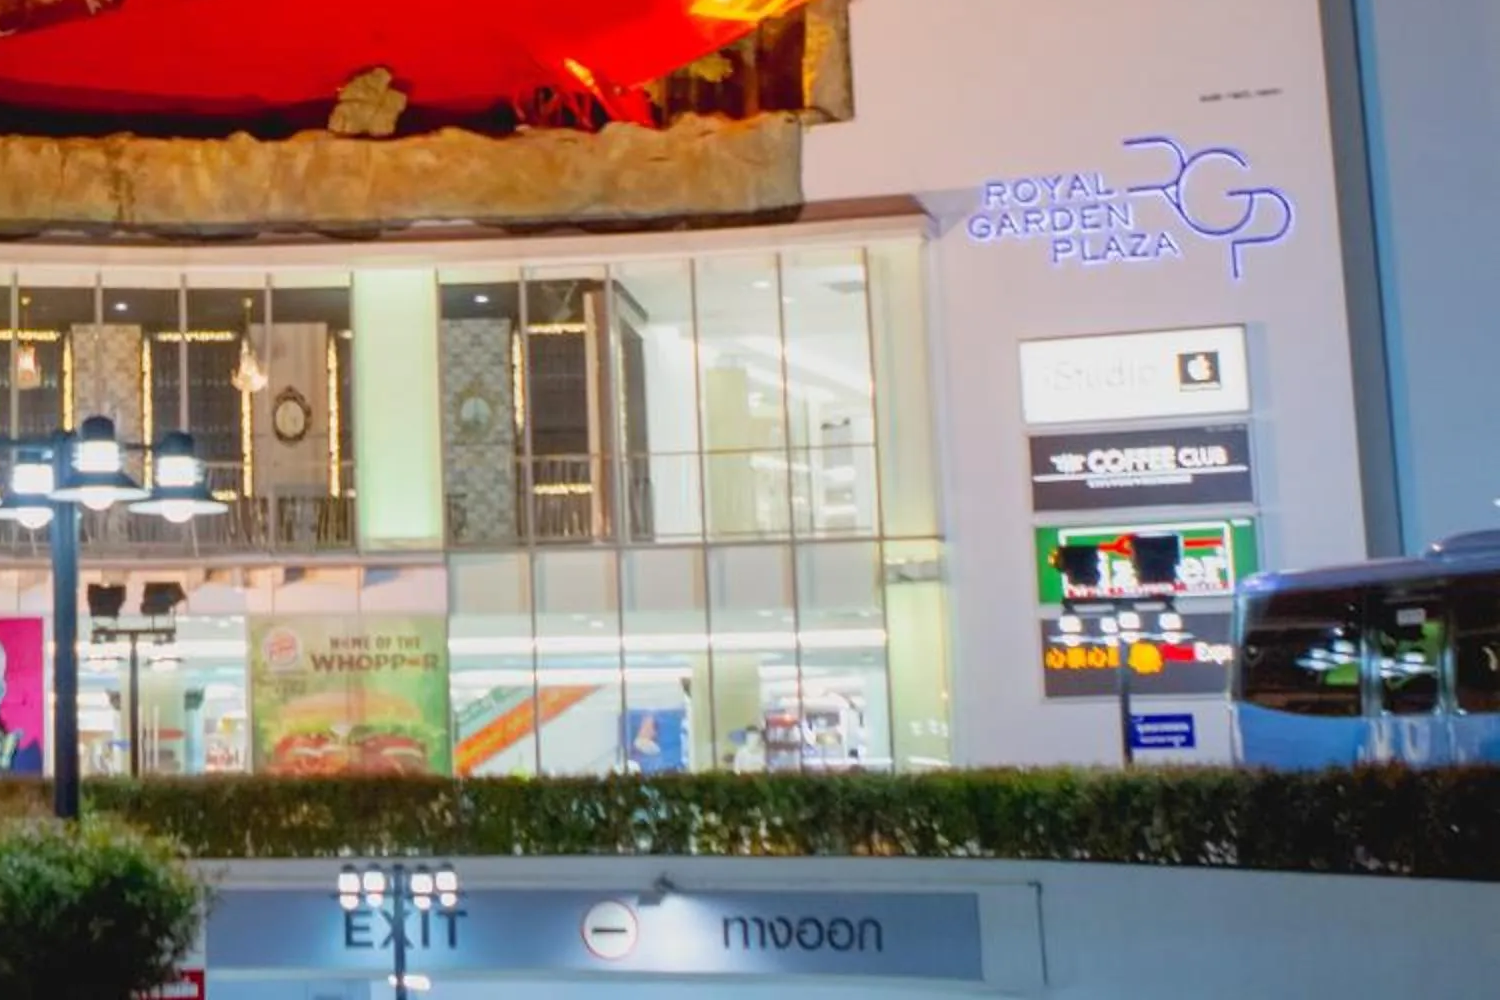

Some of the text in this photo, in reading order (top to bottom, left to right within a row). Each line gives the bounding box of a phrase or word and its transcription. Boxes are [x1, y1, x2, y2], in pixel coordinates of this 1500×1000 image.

[984, 172, 1113, 206] ROYAL
[967, 202, 1134, 239] GARDEN
[1052, 232, 1179, 264] PLAZA
[1087, 447, 1176, 474] COFFEE
[344, 910, 467, 948] EXIT
[723, 916, 883, 952] ทางออก
